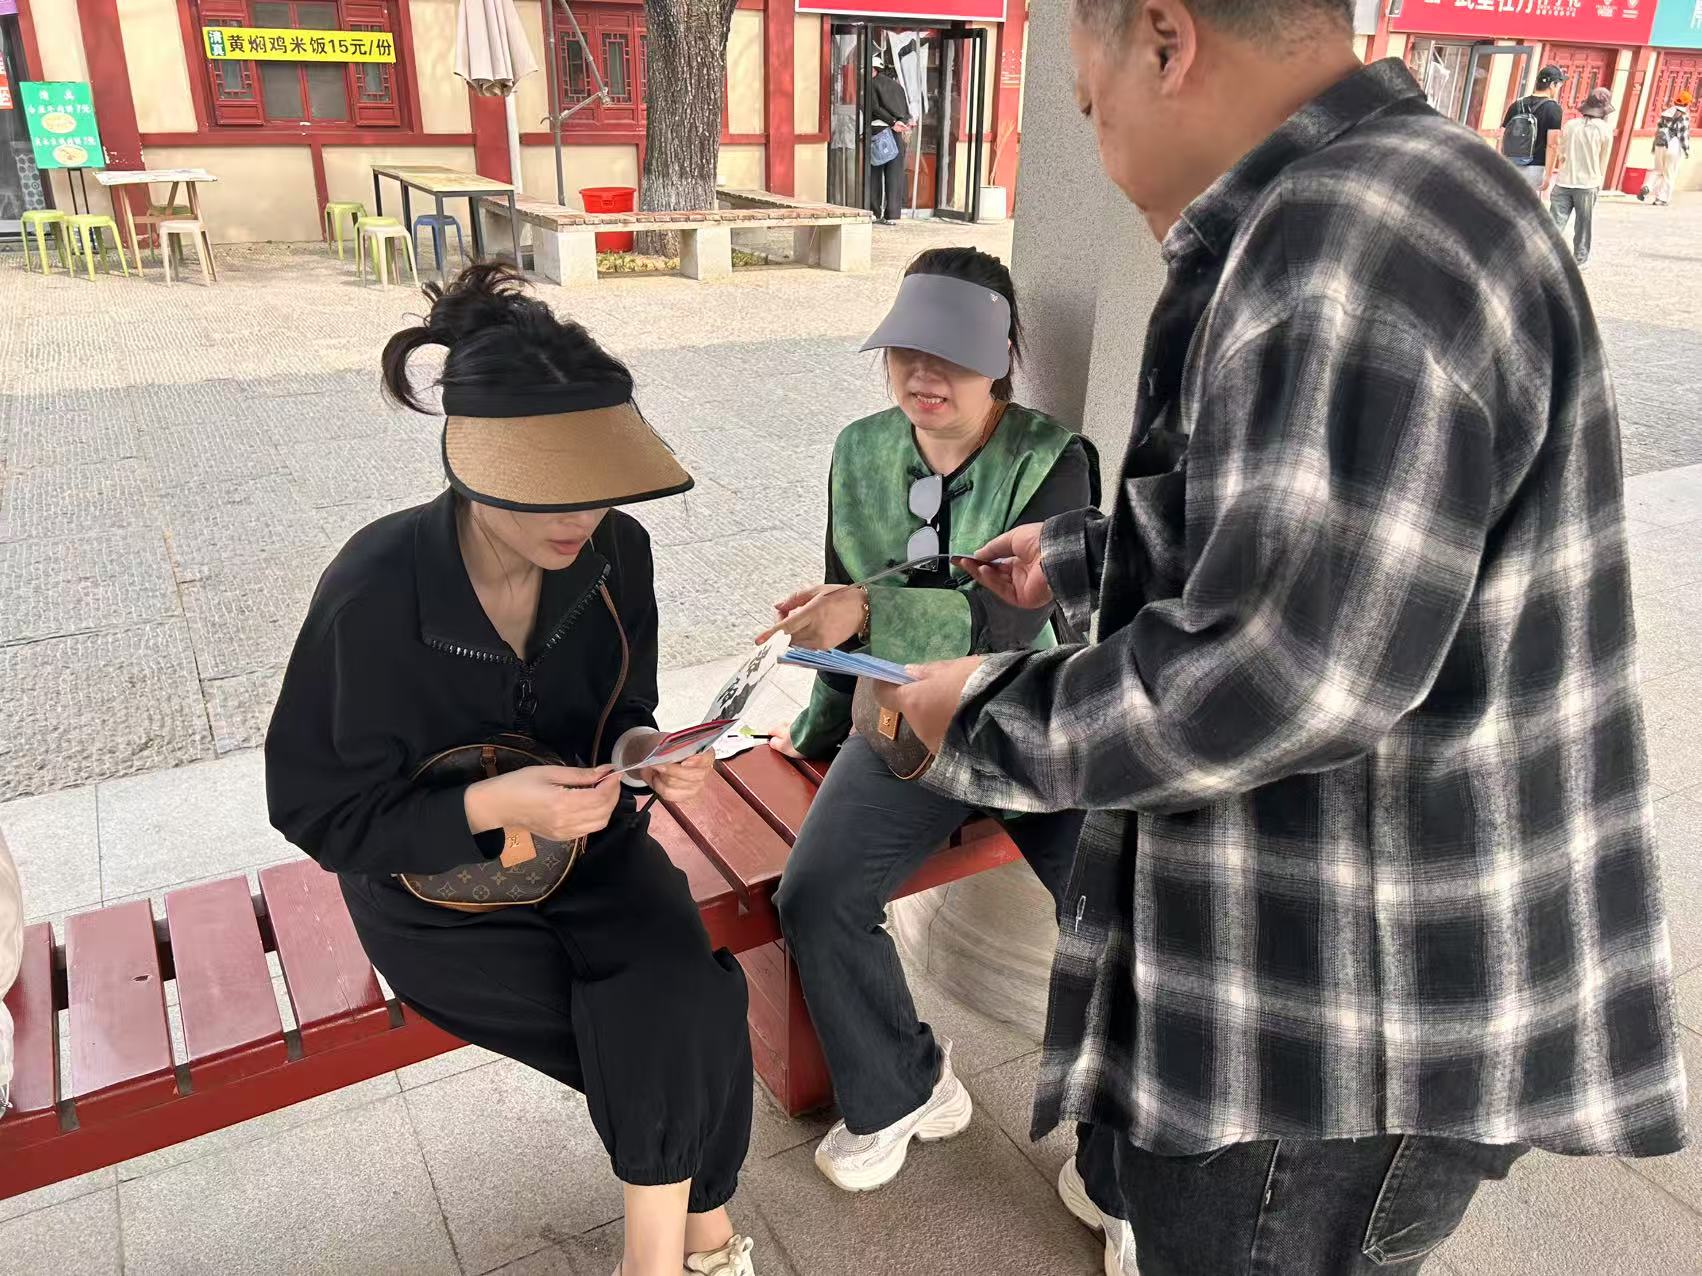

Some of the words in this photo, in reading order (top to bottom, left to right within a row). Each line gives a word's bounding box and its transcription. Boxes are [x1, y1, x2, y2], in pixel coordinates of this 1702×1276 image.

[227, 34, 392, 56] 黄焖鸡米饭15元/份
